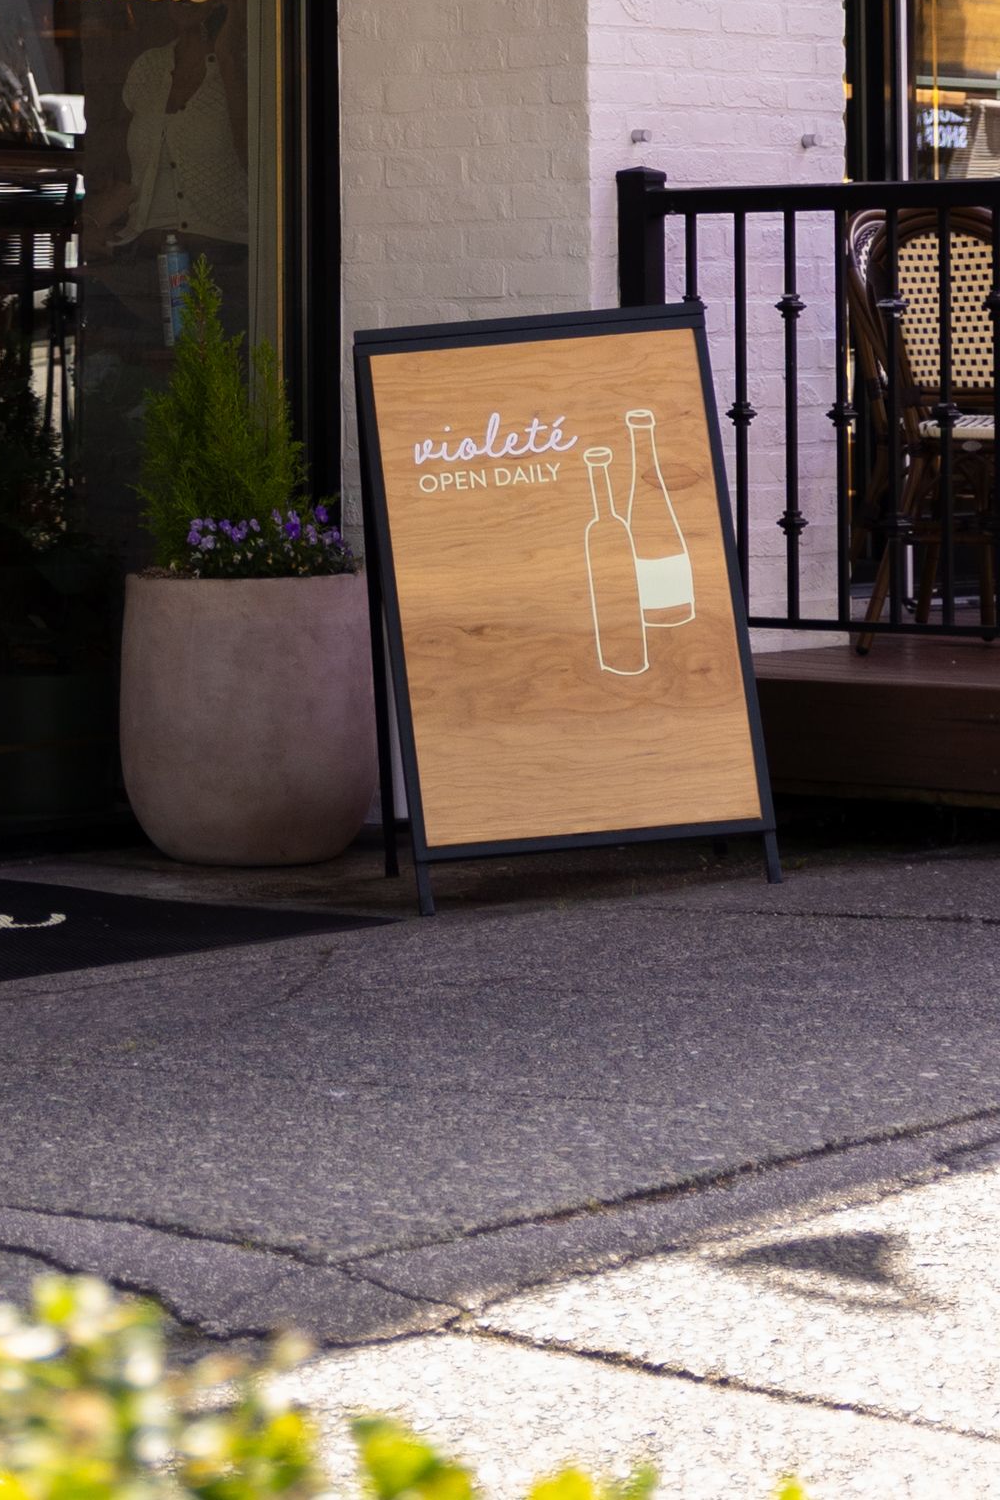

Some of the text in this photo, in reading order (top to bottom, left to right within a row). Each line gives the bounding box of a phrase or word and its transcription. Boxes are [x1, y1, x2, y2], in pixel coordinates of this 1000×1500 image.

[413, 412, 578, 465] violeté
[419, 462, 561, 493] OPEN DAILY
